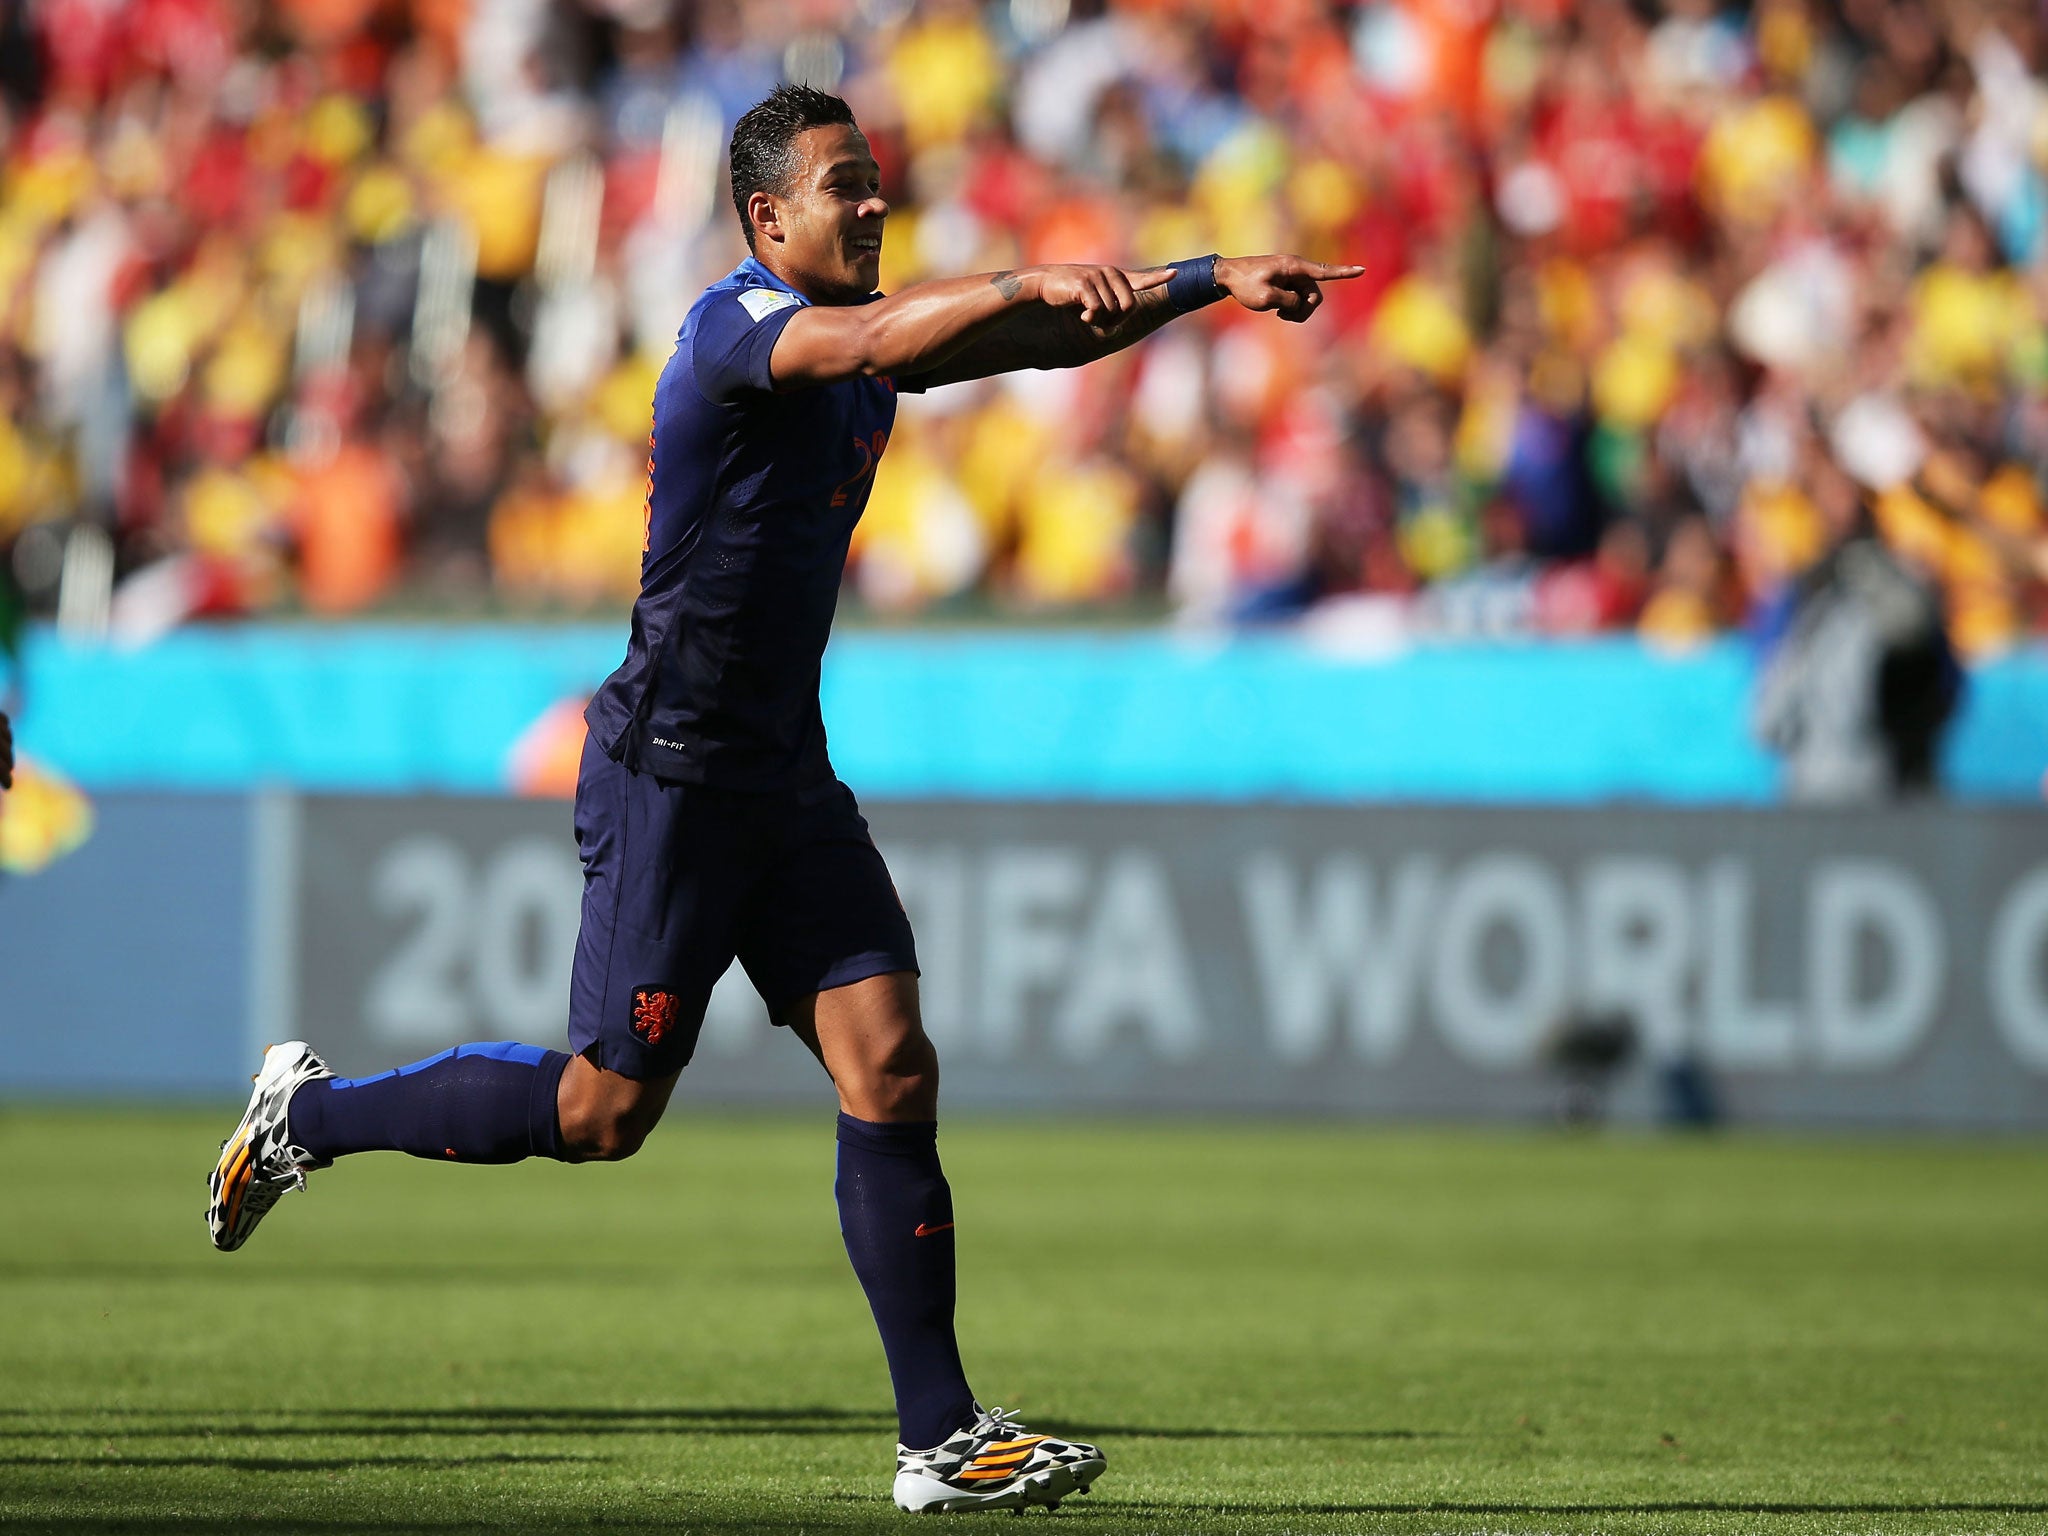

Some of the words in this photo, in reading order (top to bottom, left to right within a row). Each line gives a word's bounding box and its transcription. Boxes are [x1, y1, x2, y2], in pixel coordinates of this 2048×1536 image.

[652, 737, 685, 751] DRI-FIT
[888, 844, 1206, 1064] IFA
[1238, 850, 1947, 1070] WORLD
